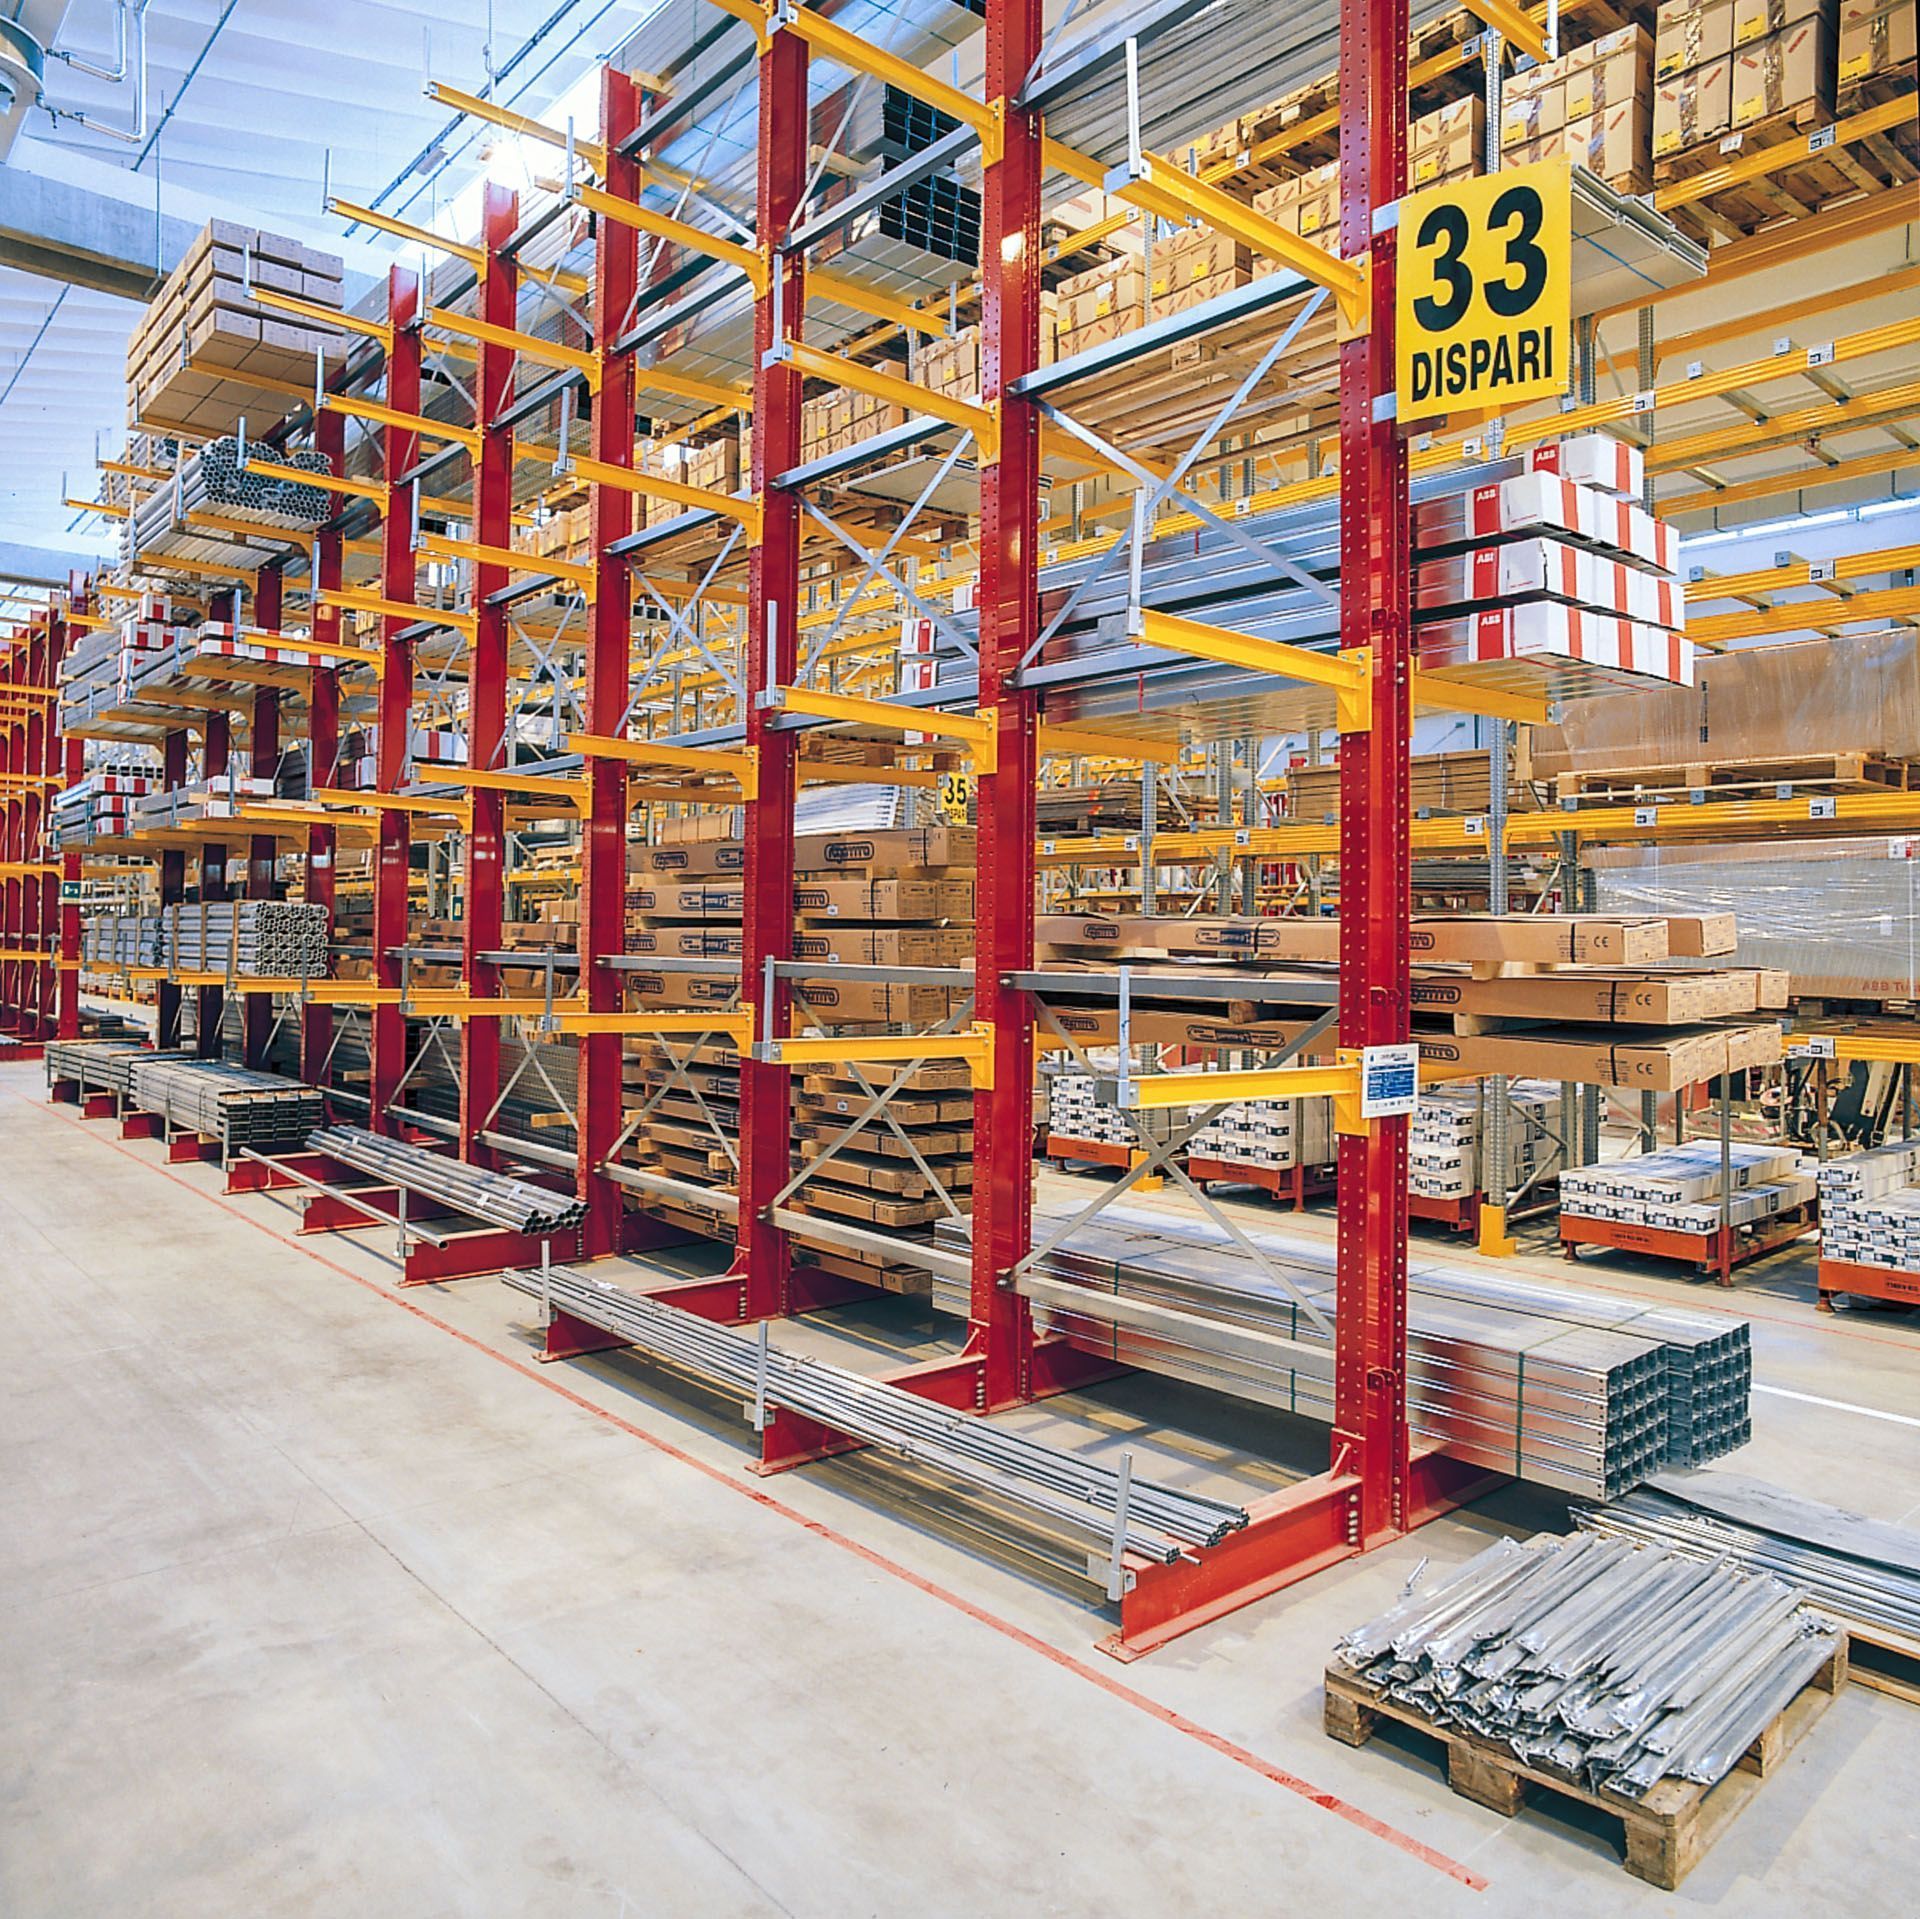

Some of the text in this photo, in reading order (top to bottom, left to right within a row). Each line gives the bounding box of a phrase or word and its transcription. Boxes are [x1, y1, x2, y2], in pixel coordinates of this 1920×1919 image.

[1413, 186, 1547, 332] 33
[1412, 325, 1553, 402] DISPARI
[1536, 450, 1555, 462] ABB
[1477, 488, 1496, 501] ABB
[1481, 614, 1501, 626] ABB
[944, 777, 967, 804] 35
[1594, 936, 1609, 948] CE
[1862, 980, 1889, 992] ABB
[1635, 993, 1652, 1006] CE
[1636, 1062, 1654, 1075] CE
